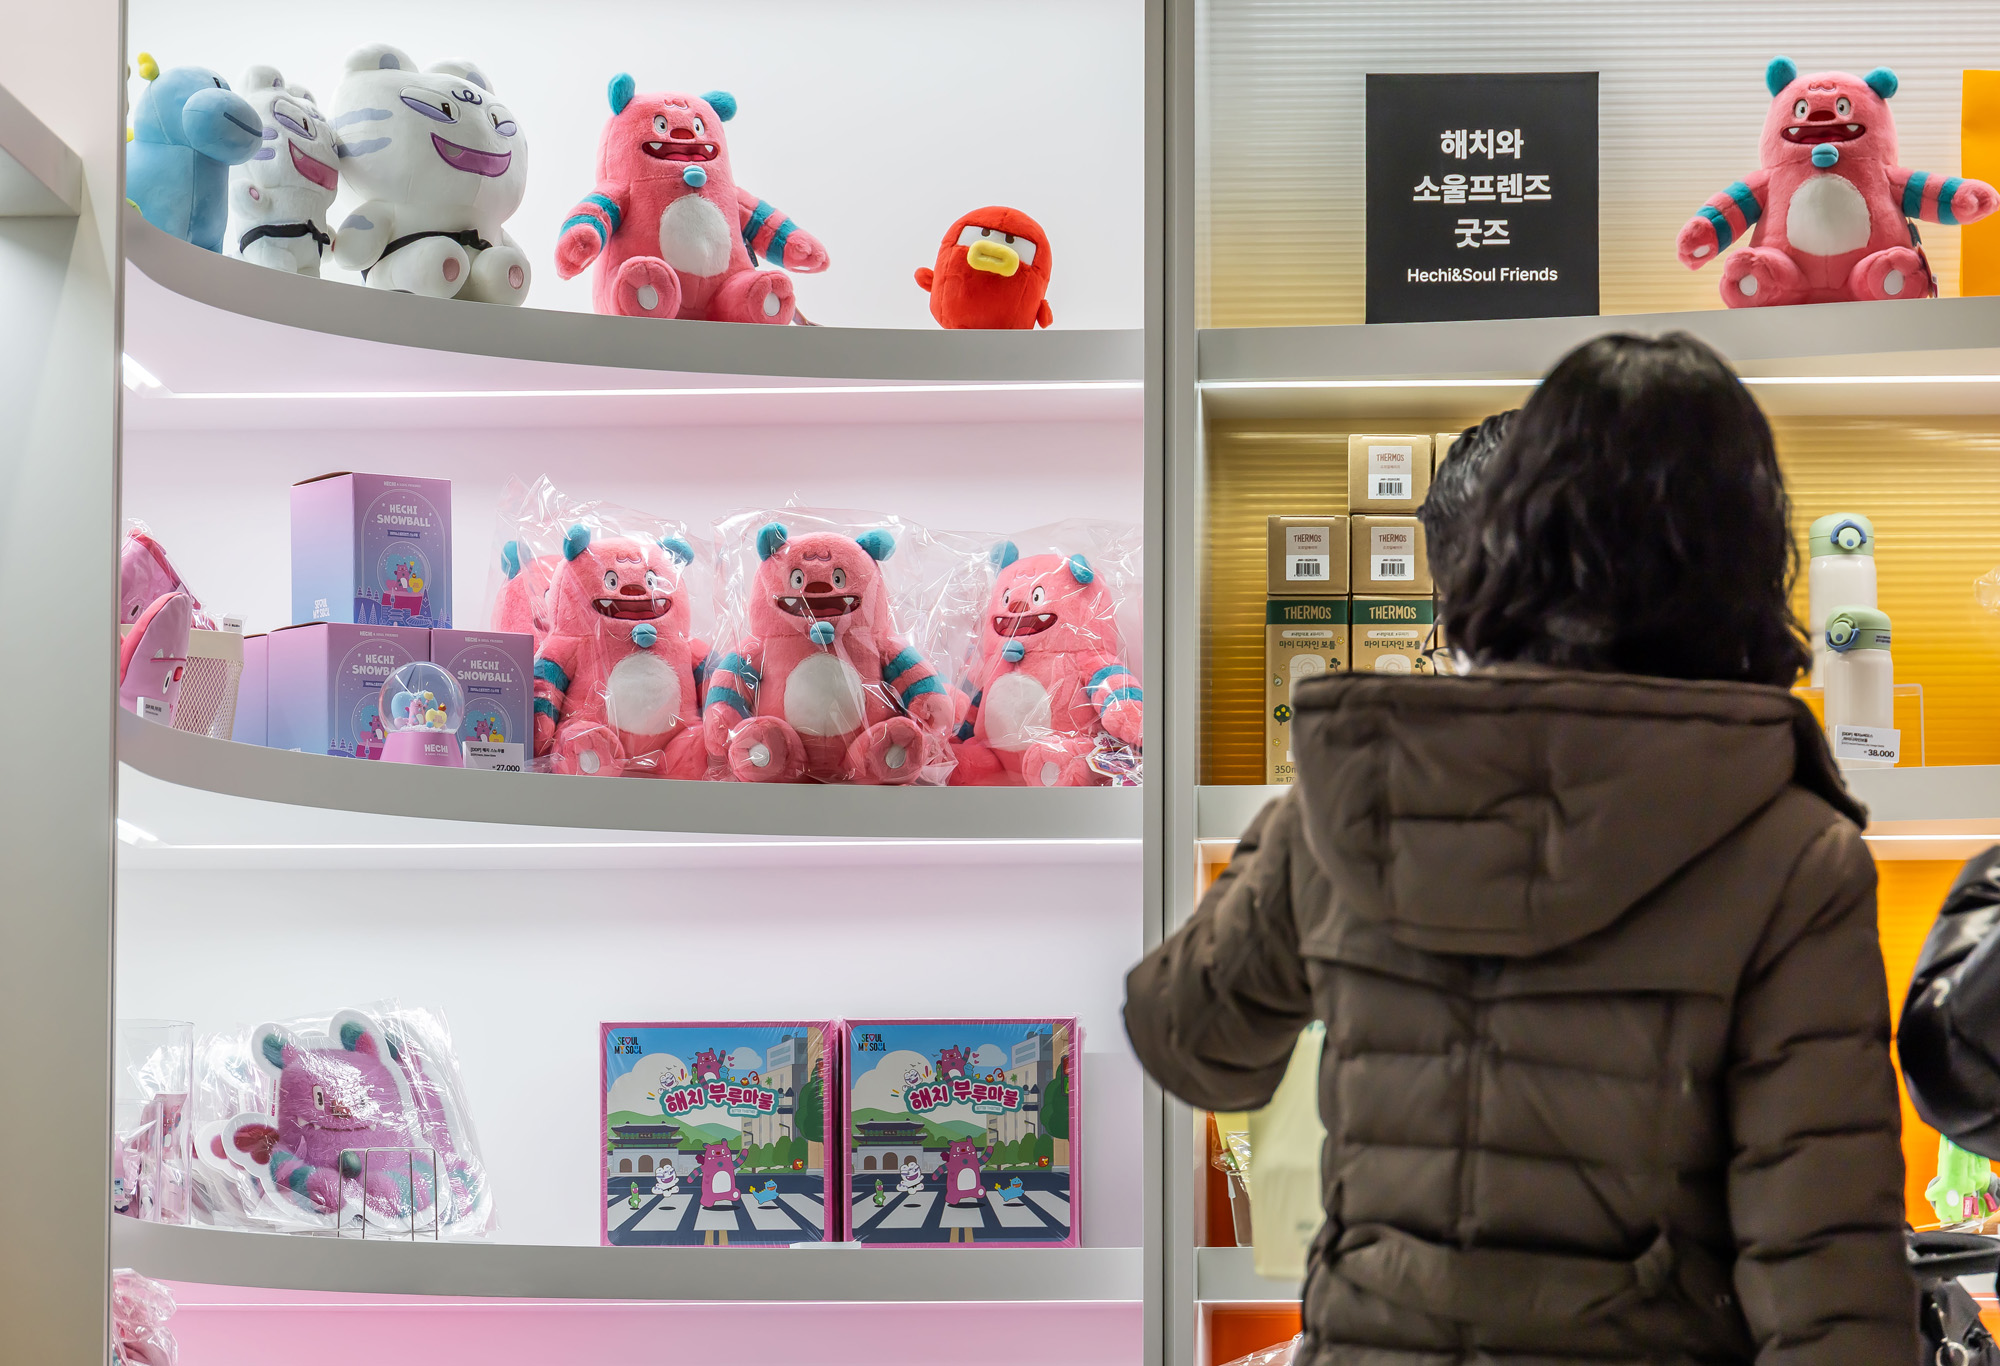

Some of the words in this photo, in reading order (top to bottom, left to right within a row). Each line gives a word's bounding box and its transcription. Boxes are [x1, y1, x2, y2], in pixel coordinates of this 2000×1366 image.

[1440, 128, 1525, 160] 해치와
[1412, 173, 1552, 204] 소울프렌즈
[1454, 218, 1511, 248] 굿즈
[1407, 267, 1496, 283] Hechi&Soul
[1500, 266, 1558, 282] Friends
[1376, 453, 1405, 462] THERMOS
[389, 504, 418, 515] HECHI
[376, 514, 431, 528] SNOWBALL
[1293, 533, 1322, 543] THERMOS
[1378, 533, 1407, 543] THERMOS
[1283, 605, 1332, 620] THERMOS
[1368, 605, 1417, 620] THERMOS
[1279, 640, 1295, 649] 마이
[1296, 640, 1320, 650] 디자인
[1320, 640, 1337, 650] 보틀
[1364, 640, 1380, 649] 마이
[1381, 640, 1405, 650] 디자인
[1406, 640, 1421, 650] 보틀
[365, 654, 395, 665] HECHI
[470, 659, 499, 671] HECHI
[352, 664, 397, 676] SNOWBA
[457, 670, 513, 683] SNOWBALL
[424, 743, 449, 754] HECHI
[617, 1036, 639, 1046] SEOUL
[861, 1033, 883, 1043] SEOUL
[614, 1045, 625, 1055] MY
[625, 1045, 643, 1055] SOUL
[858, 1042, 868, 1052] MY
[869, 1042, 887, 1052] SOUL
[665, 1088, 704, 1113] 해치
[708, 1083, 774, 1111] 부루마불
[909, 1085, 949, 1110] 해치
[953, 1080, 1019, 1108] 부루마불
